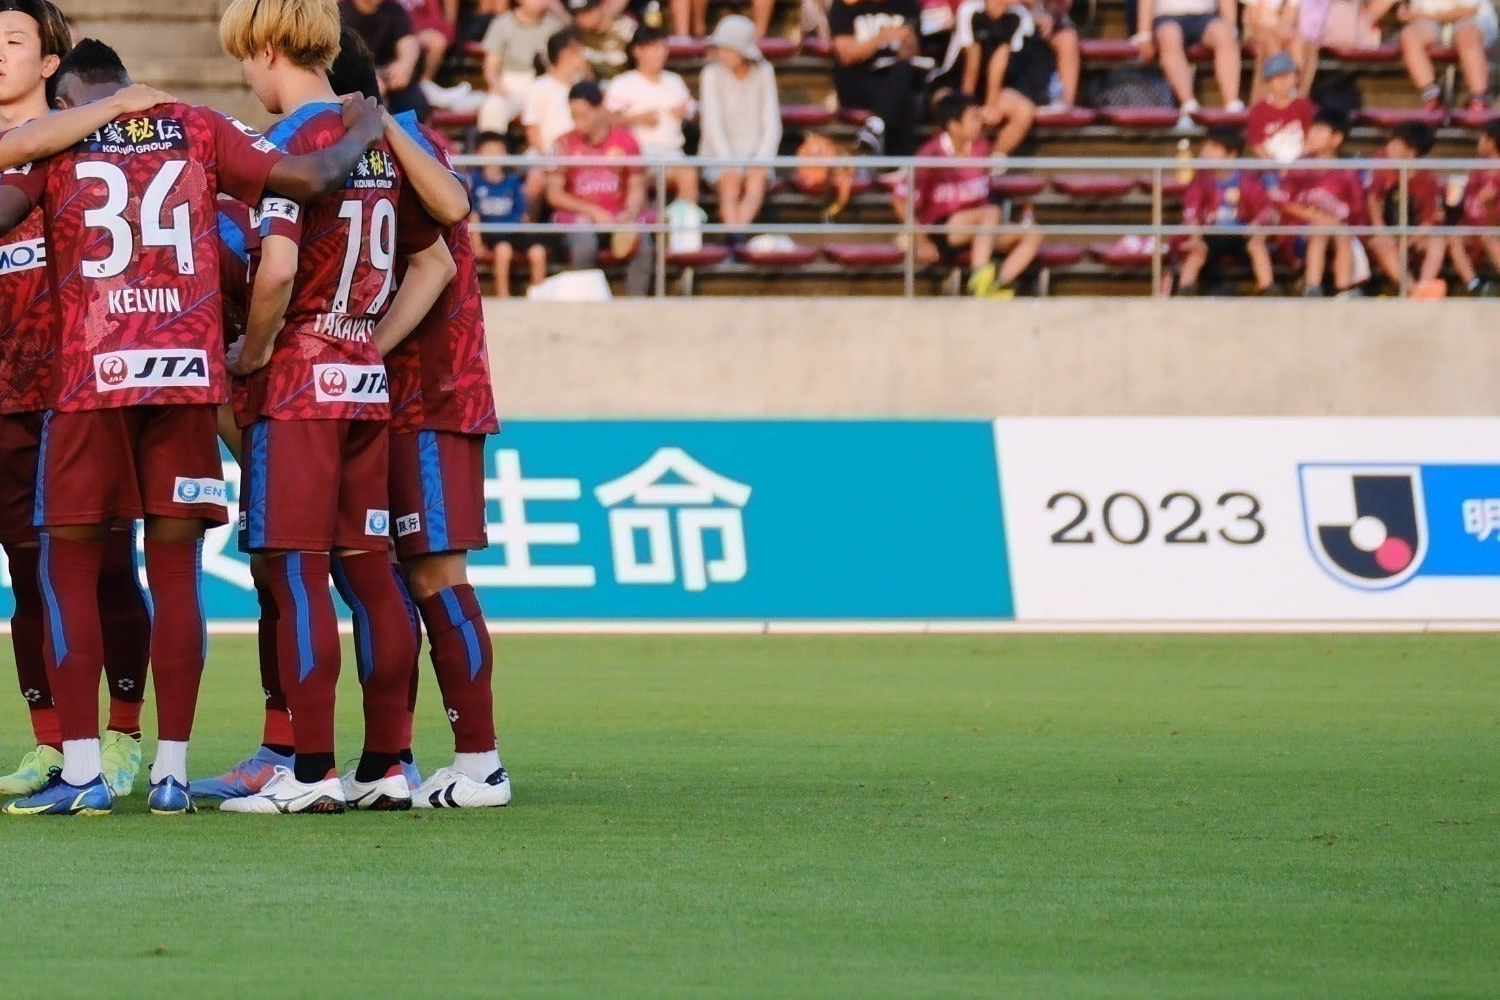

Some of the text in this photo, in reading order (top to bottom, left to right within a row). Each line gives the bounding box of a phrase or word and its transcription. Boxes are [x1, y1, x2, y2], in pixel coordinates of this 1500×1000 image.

[102, 141, 173, 155] KOUWA GROUP
[350, 150, 397, 178] 豪秘伝
[74, 160, 195, 278] 34
[331, 198, 396, 314] 19
[108, 287, 182, 314] KELVIN
[108, 356, 206, 383] JAL JTA
[352, 372, 389, 394] JTA
[1045, 489, 1267, 546] 2023
